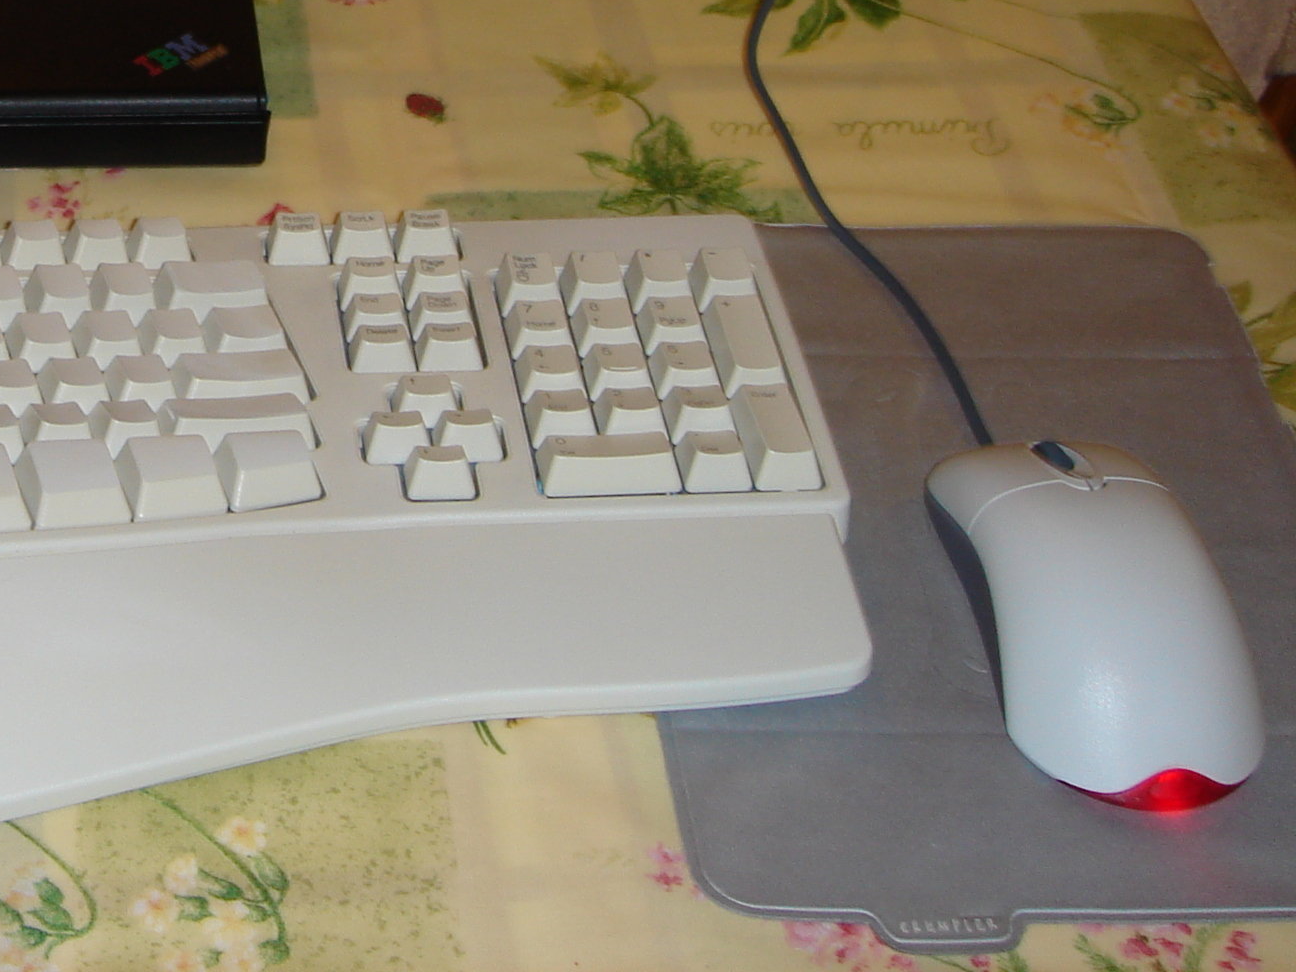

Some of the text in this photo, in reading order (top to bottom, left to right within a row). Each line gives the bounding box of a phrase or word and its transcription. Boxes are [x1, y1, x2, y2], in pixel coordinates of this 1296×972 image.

[131, 32, 209, 77] IBM
[832, 117, 1012, 157] Primula
[898, 916, 999, 934] CRUMPLER
